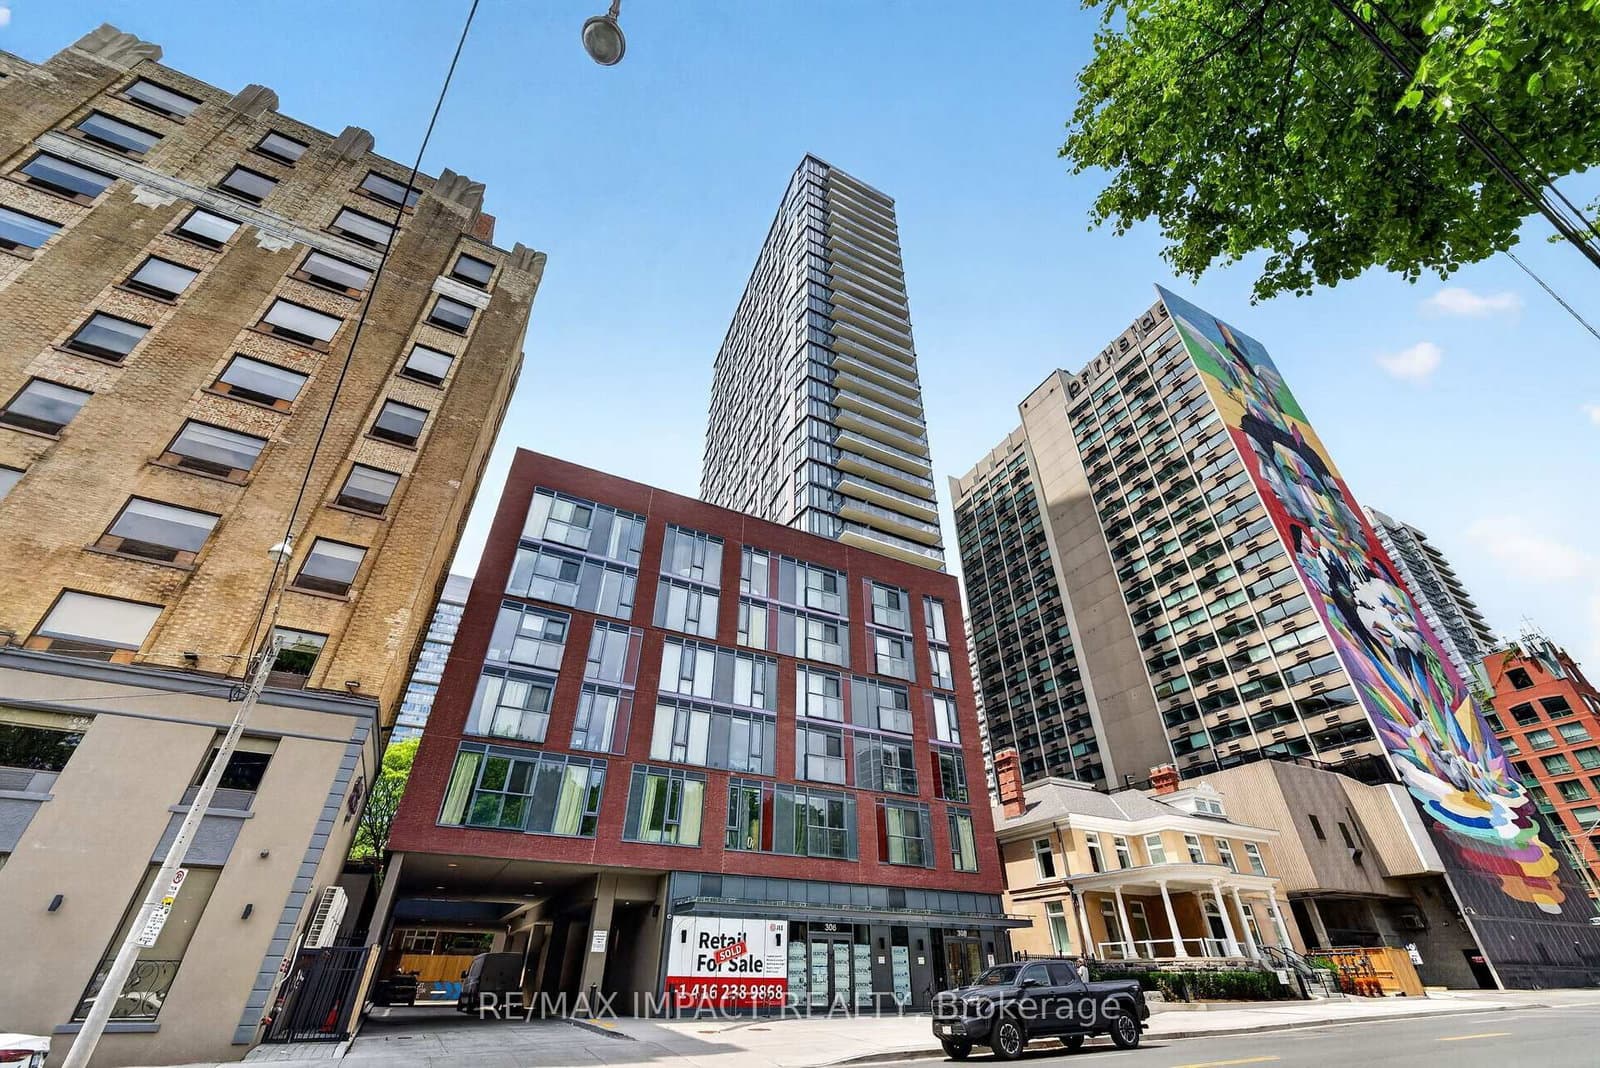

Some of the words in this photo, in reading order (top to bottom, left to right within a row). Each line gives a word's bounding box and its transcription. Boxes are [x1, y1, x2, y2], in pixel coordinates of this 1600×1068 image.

[699, 932, 747, 949] Retail
[719, 945, 742, 960] SOLD
[728, 954, 763, 972] Sale
[691, 984, 718, 999] 416
[721, 984, 746, 999] 238
[750, 984, 783, 999] 9868
